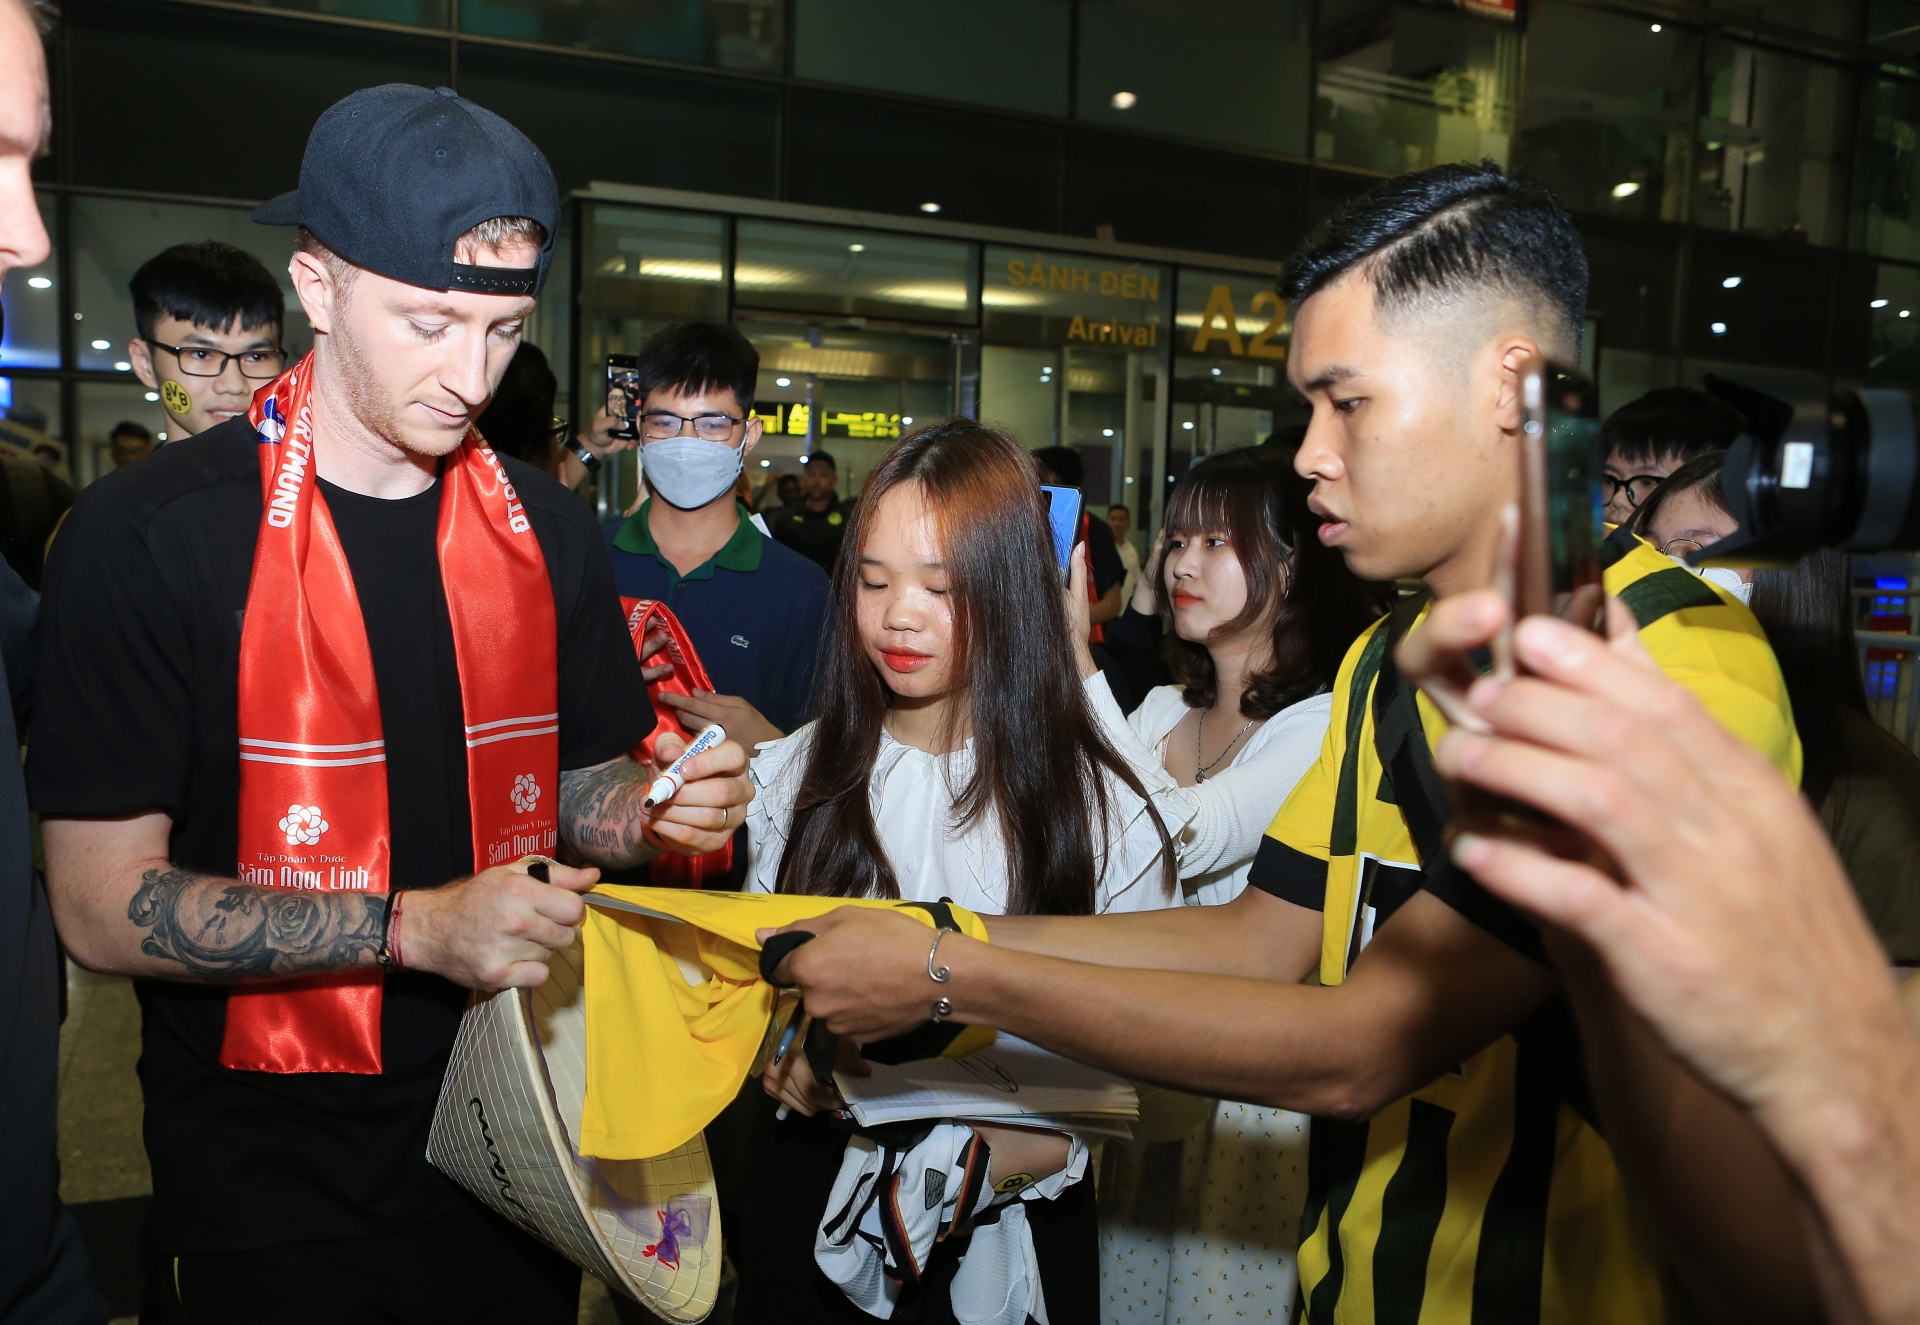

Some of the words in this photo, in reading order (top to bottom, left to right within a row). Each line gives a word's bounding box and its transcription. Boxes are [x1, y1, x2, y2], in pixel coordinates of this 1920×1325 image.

[1007, 251, 1090, 293] SẢNH
[1100, 263, 1159, 302] ĐẾN
[1067, 313, 1157, 347] Arrival
[1192, 284, 1288, 359] A2
[257, 852, 276, 864] Tập
[309, 855, 317, 863] Y
[488, 841, 510, 865] Sâm
[543, 826, 558, 849] Lin
[237, 862, 274, 887] Sâm
[280, 865, 324, 892] Ngọc
[330, 865, 369, 890] Linh
